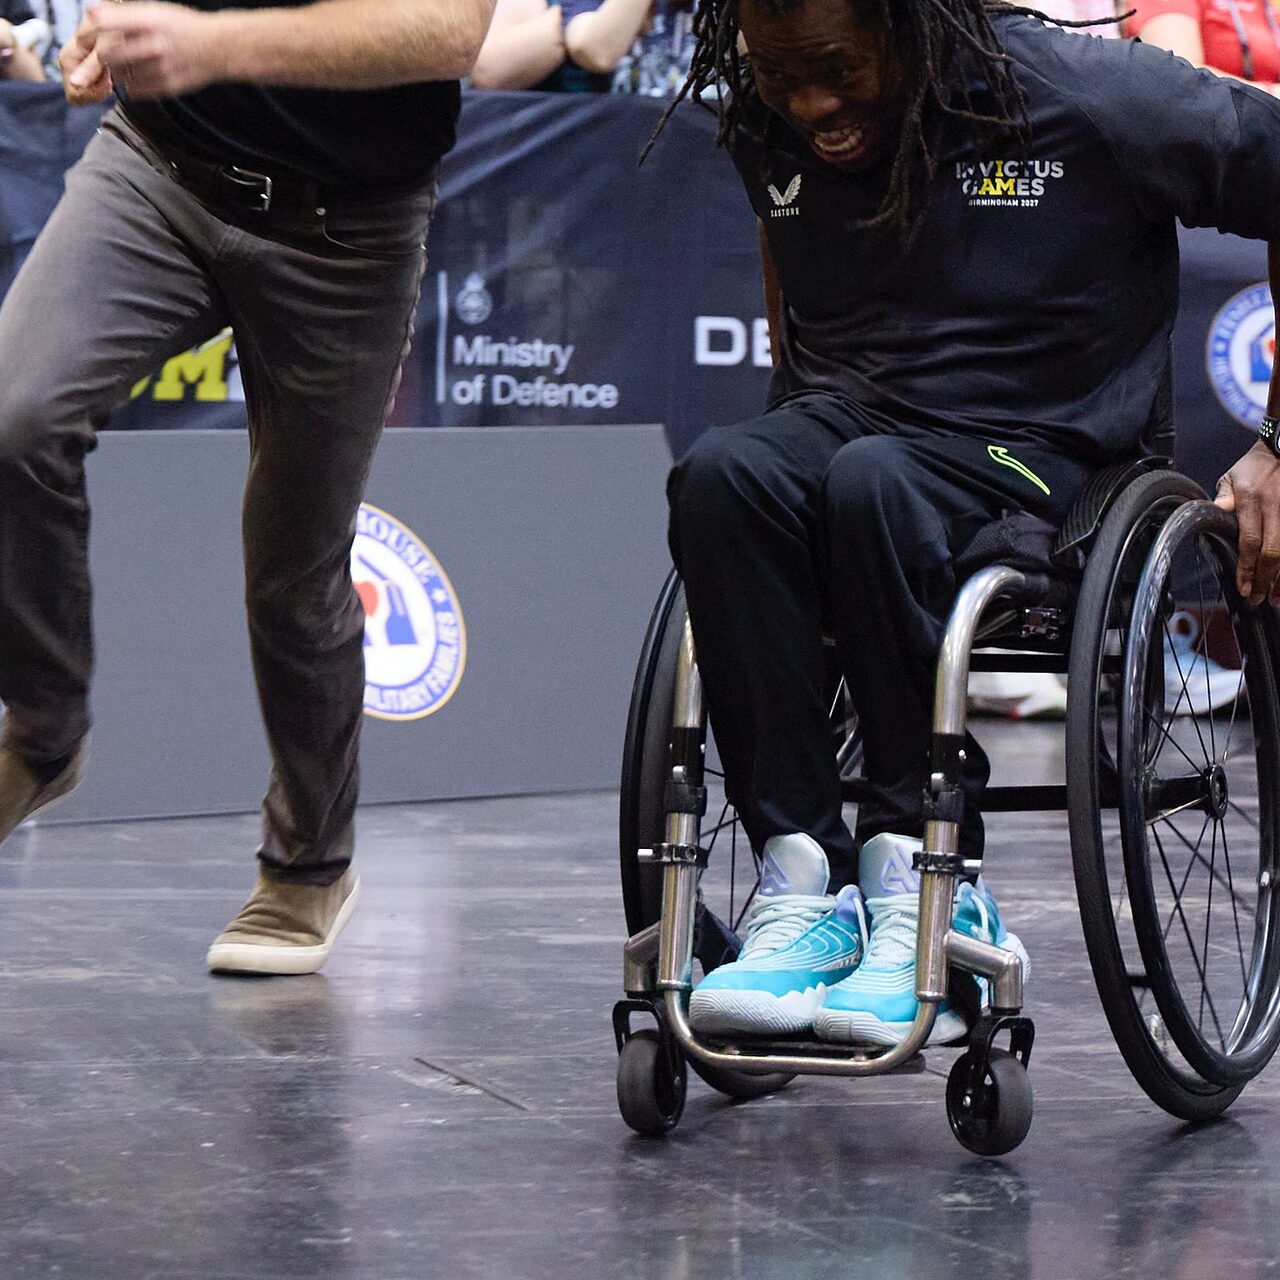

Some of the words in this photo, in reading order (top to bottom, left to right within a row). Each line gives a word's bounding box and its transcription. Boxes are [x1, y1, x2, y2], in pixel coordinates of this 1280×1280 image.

[962, 178, 1045, 196] GAMES
[1021, 199, 1039, 207] 2027
[453, 335, 575, 375] Ministry
[452, 375, 485, 406] of
[492, 375, 619, 409] Defence
